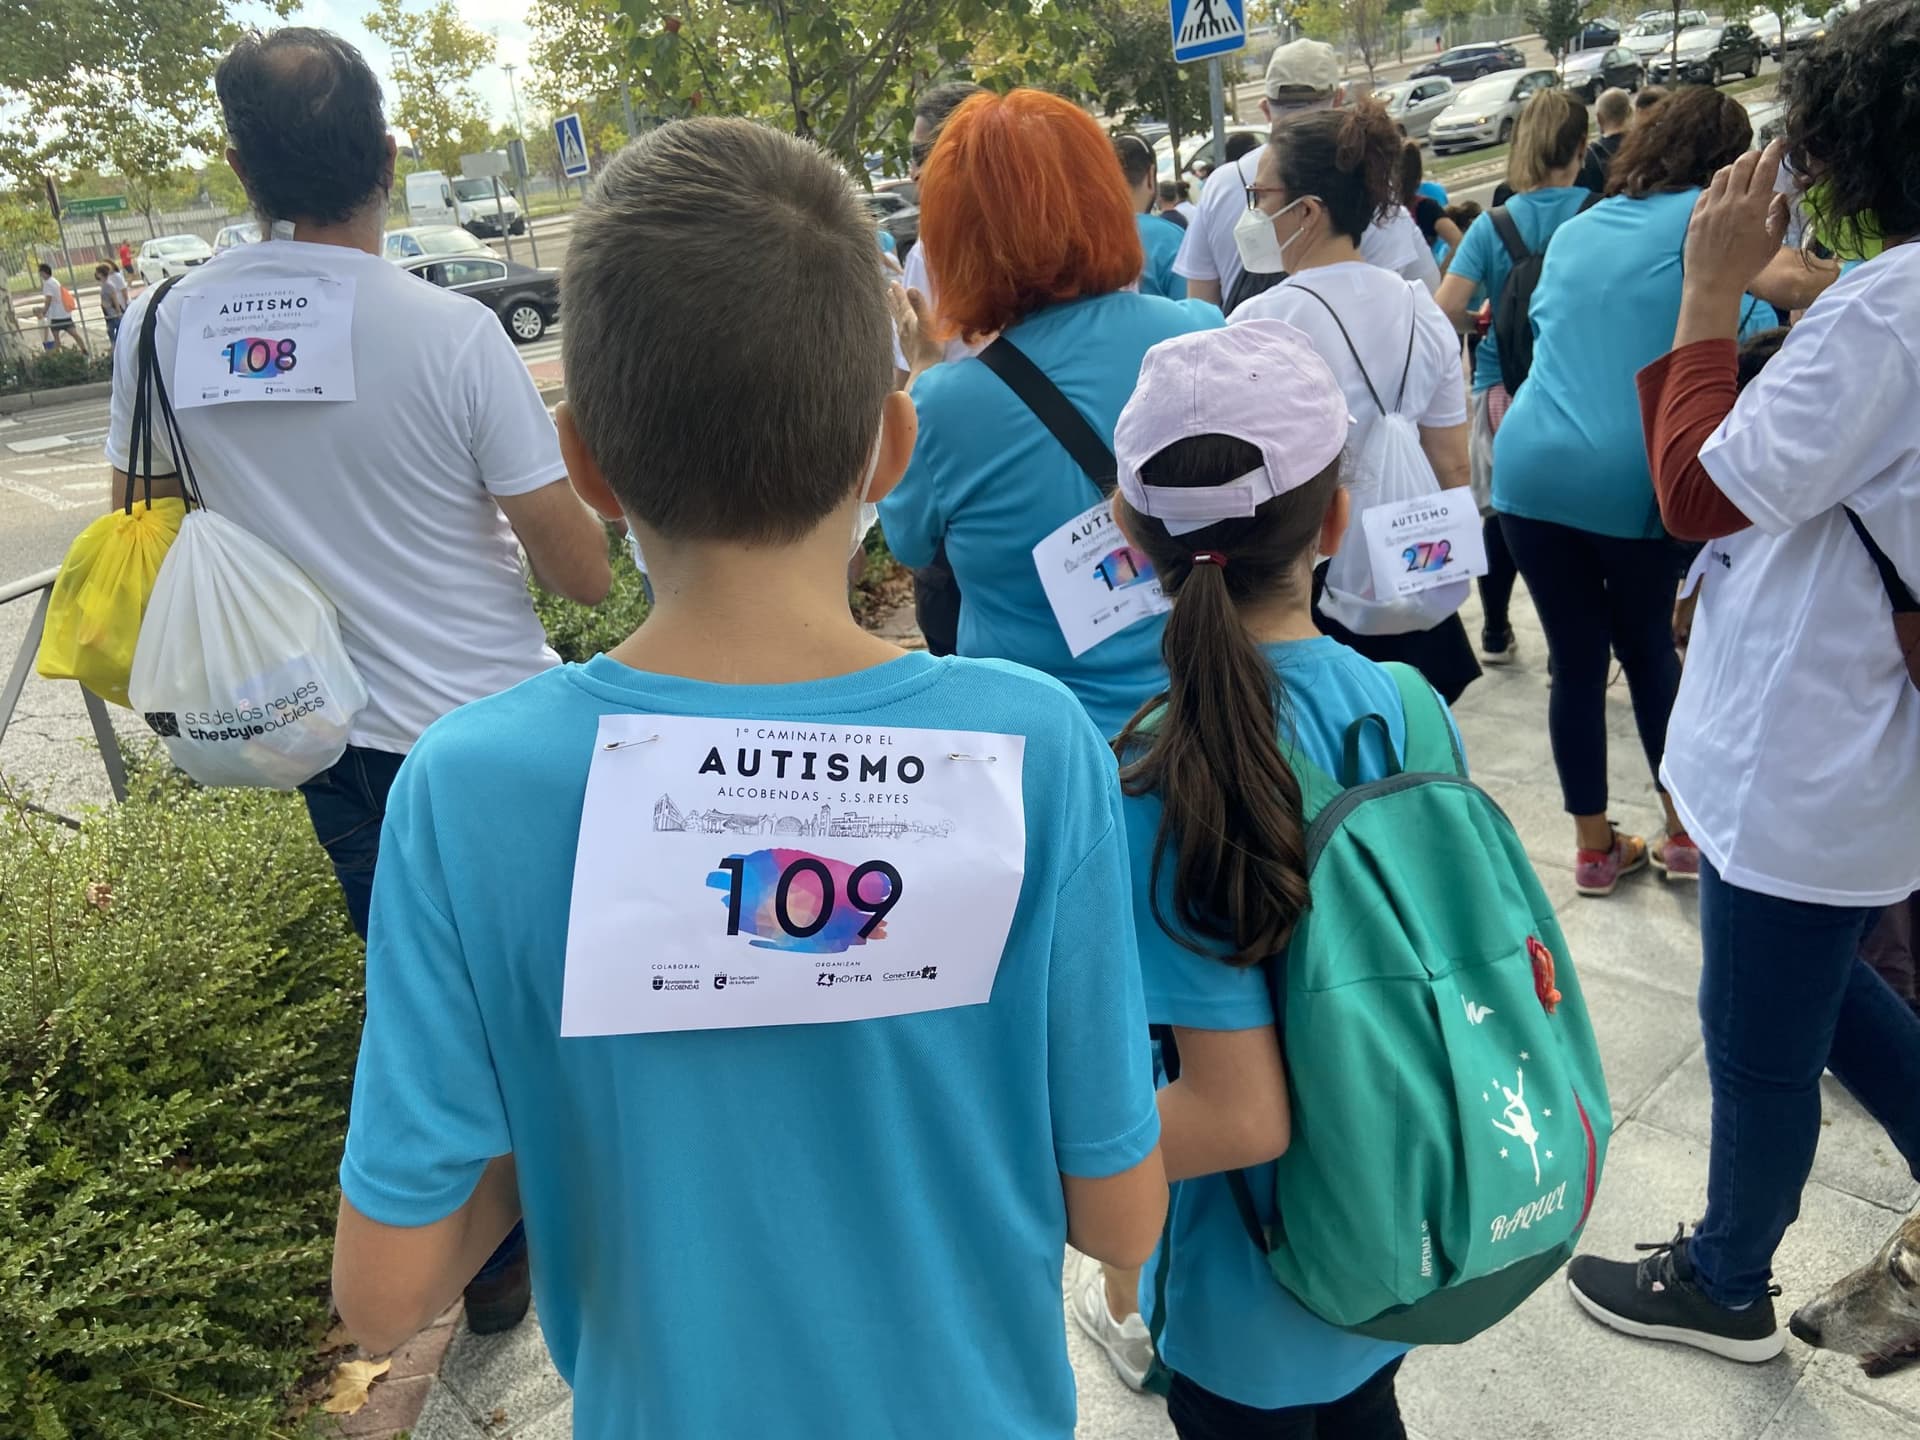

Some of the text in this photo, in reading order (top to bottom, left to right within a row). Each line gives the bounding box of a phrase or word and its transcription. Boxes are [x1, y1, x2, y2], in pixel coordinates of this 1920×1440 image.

[219, 297, 308, 316] AUTISMO
[226, 338, 297, 374] 108
[1071, 512, 1113, 545] AUTI
[1391, 507, 1448, 529] AUTISMO
[1094, 549, 1139, 591] 11
[1401, 539, 1454, 573] 272
[265, 681, 318, 717] reyes
[757, 728, 837, 743] CAMINATA
[845, 733, 872, 745] POR
[879, 735, 893, 745] EL
[698, 746, 925, 784] AUTISMO
[717, 786, 820, 802] ALCOBENDAS
[840, 792, 909, 804] S.S.REYES
[718, 858, 903, 939] 109
